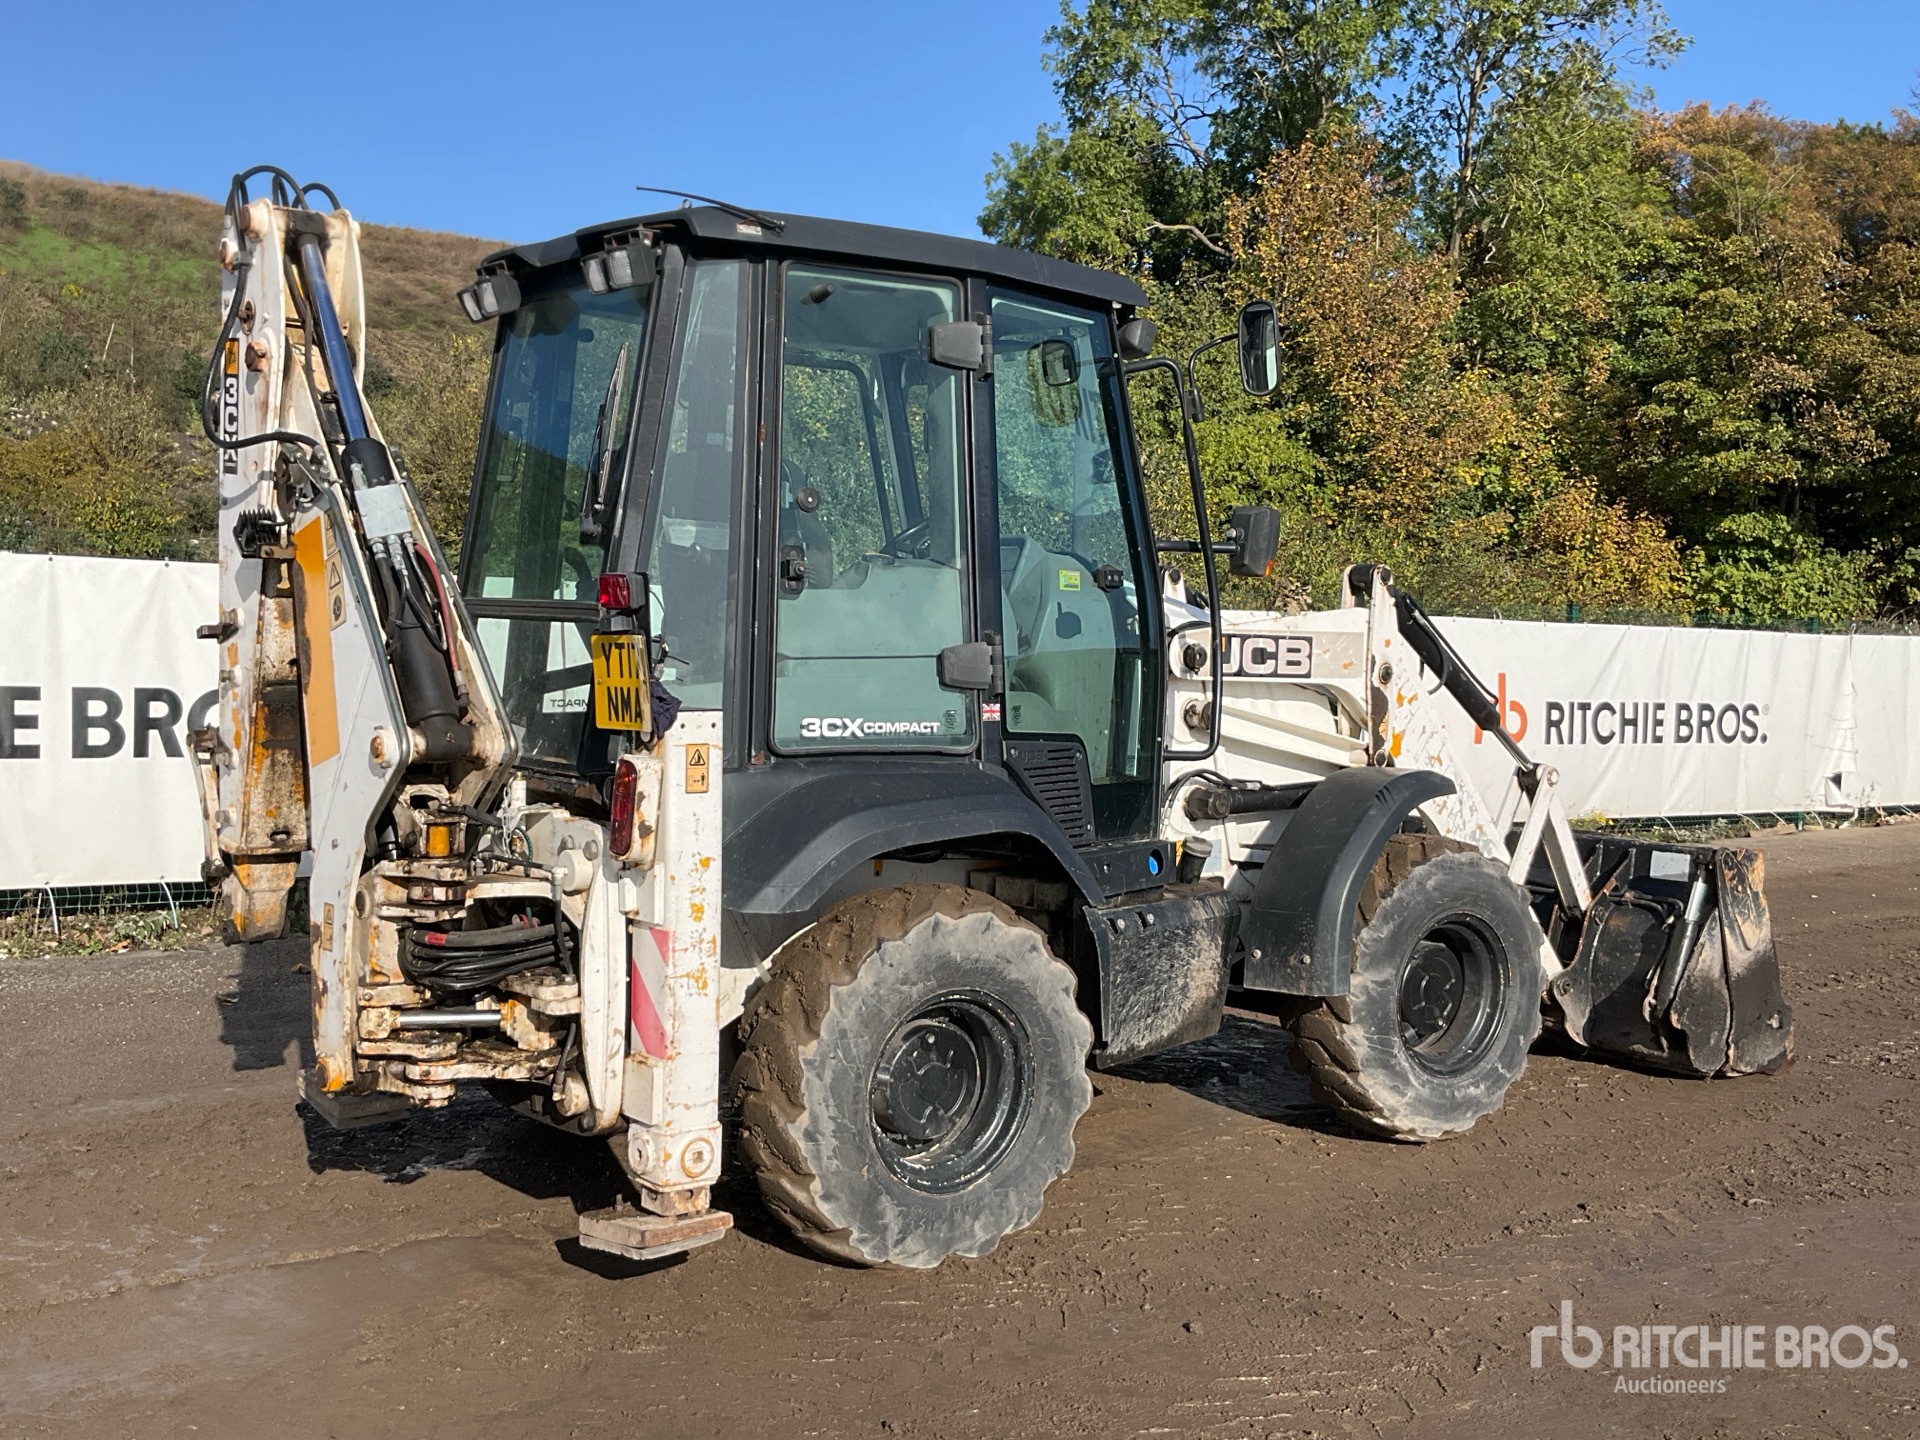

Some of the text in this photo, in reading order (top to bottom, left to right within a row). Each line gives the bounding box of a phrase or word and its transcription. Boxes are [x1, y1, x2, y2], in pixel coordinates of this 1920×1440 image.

[1222, 637, 1311, 675] JCB
[71, 686, 220, 759] BR
[607, 686, 643, 723] NMA
[1474, 672, 1528, 745] b
[1544, 701, 1769, 745] RITCHIE BROS.
[801, 717, 940, 738] 3CX COMPACT
